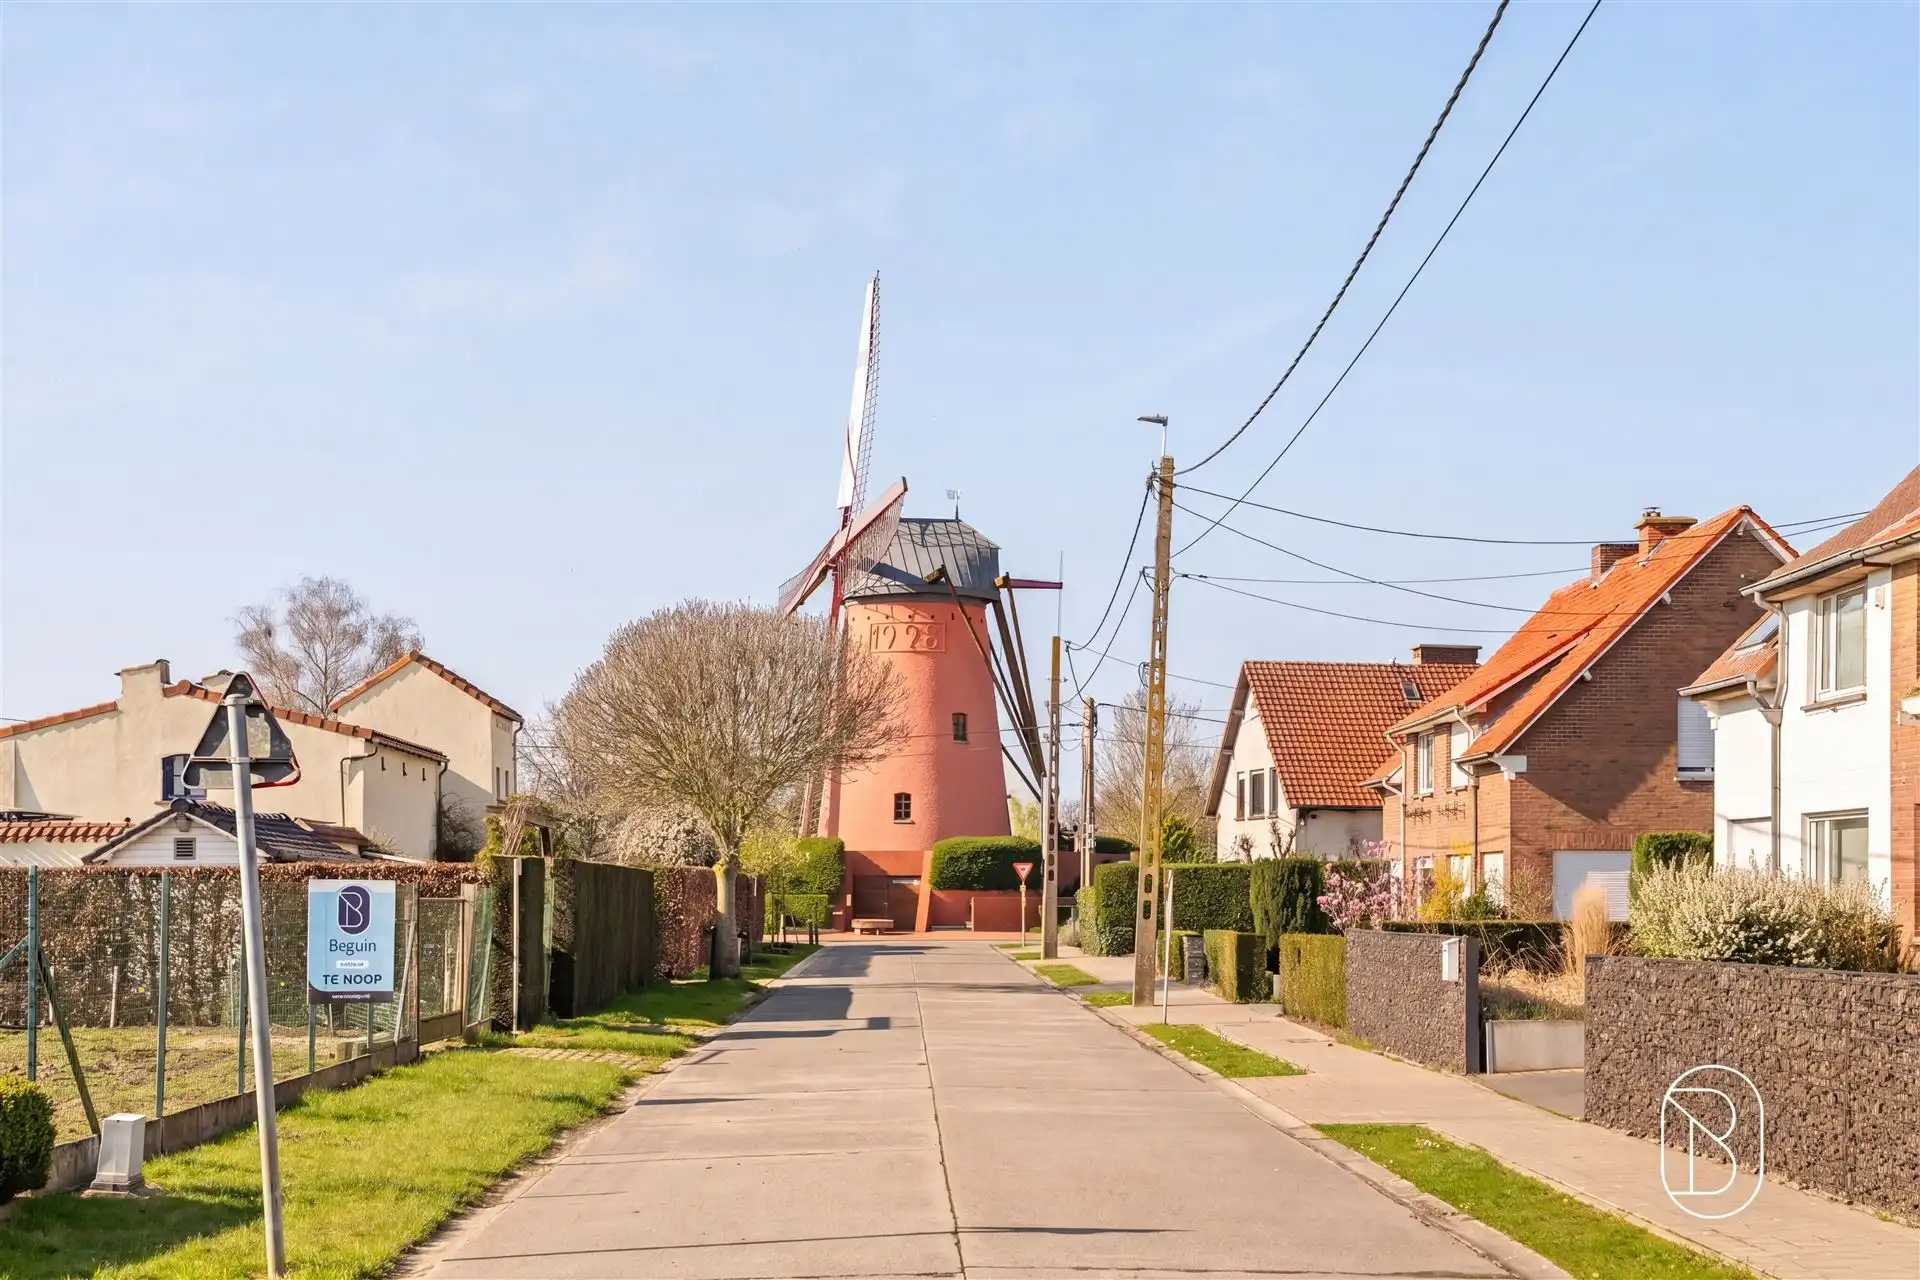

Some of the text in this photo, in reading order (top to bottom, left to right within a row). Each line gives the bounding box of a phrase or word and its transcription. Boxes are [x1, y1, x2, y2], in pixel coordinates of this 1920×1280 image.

[329, 938, 376, 956] Beguin
[322, 974, 382, 985] TE NOOP
